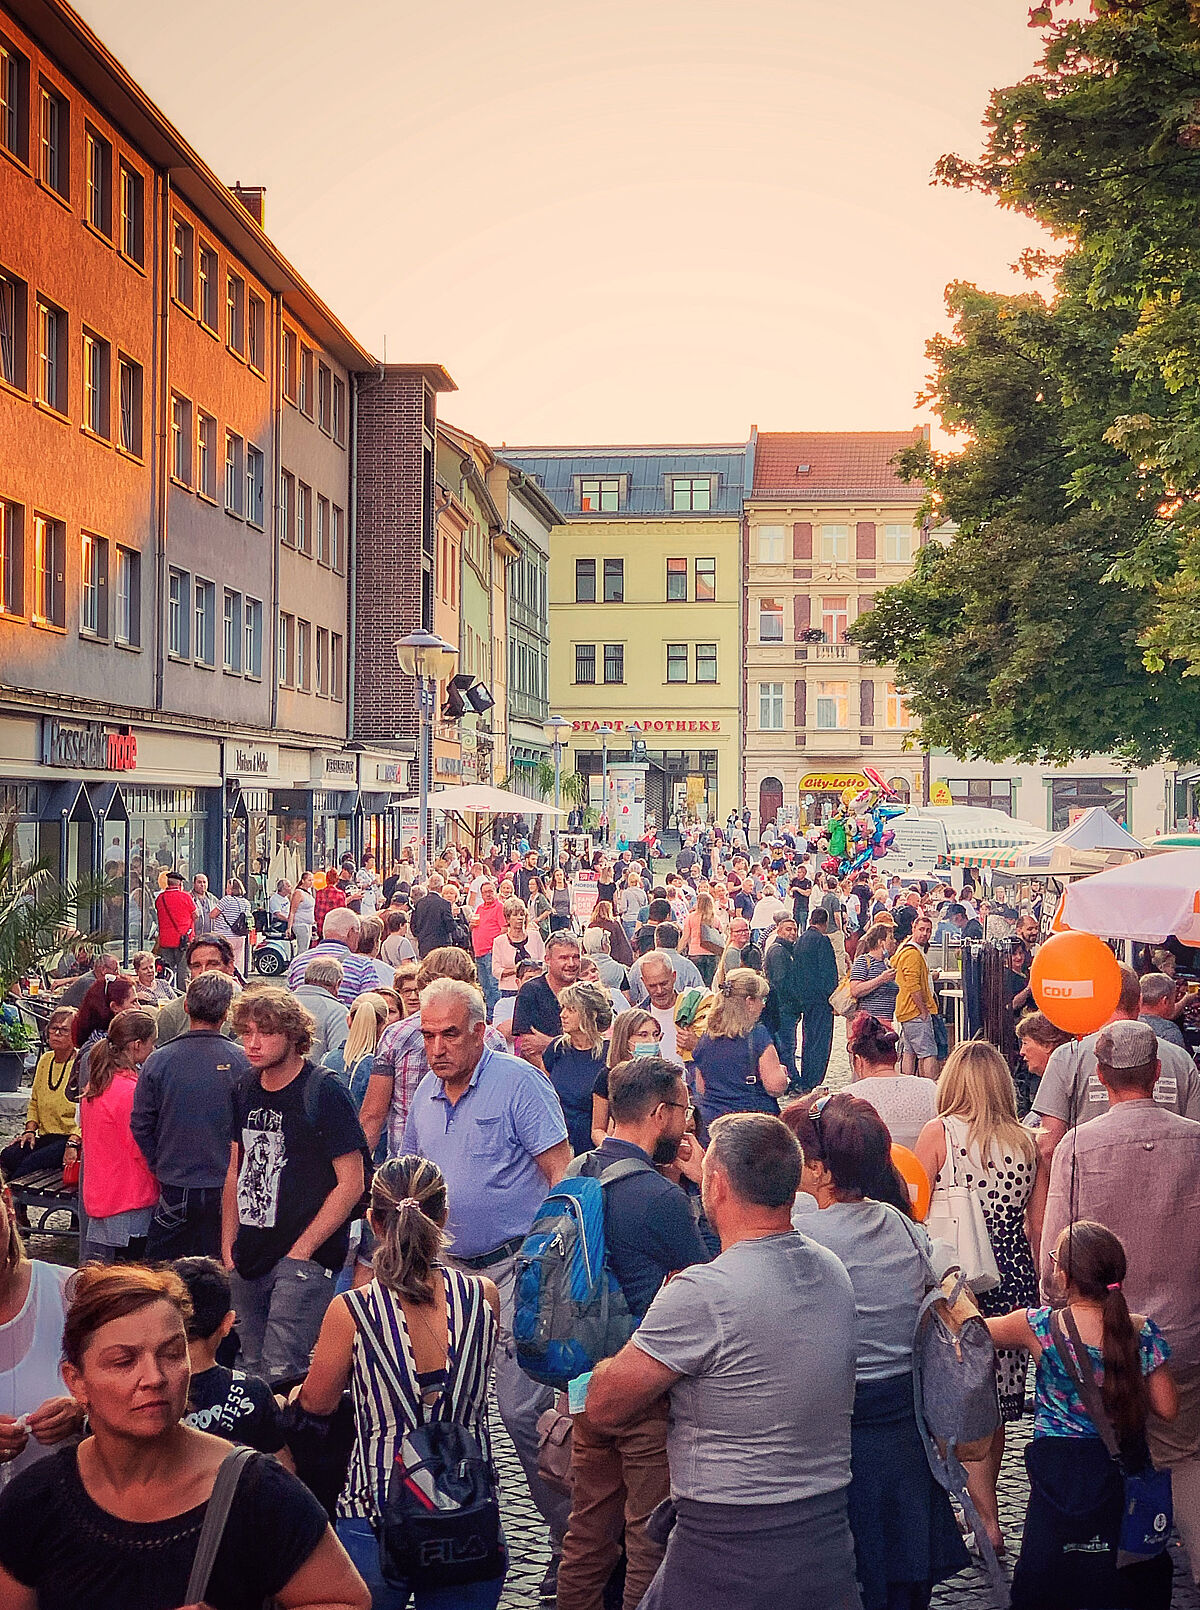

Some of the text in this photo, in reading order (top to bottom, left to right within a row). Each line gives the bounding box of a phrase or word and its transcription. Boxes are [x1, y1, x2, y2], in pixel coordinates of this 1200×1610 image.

[107, 725, 137, 770] mode
[804, 778, 865, 789] City-Lotto
[1044, 986, 1072, 997] CDU
